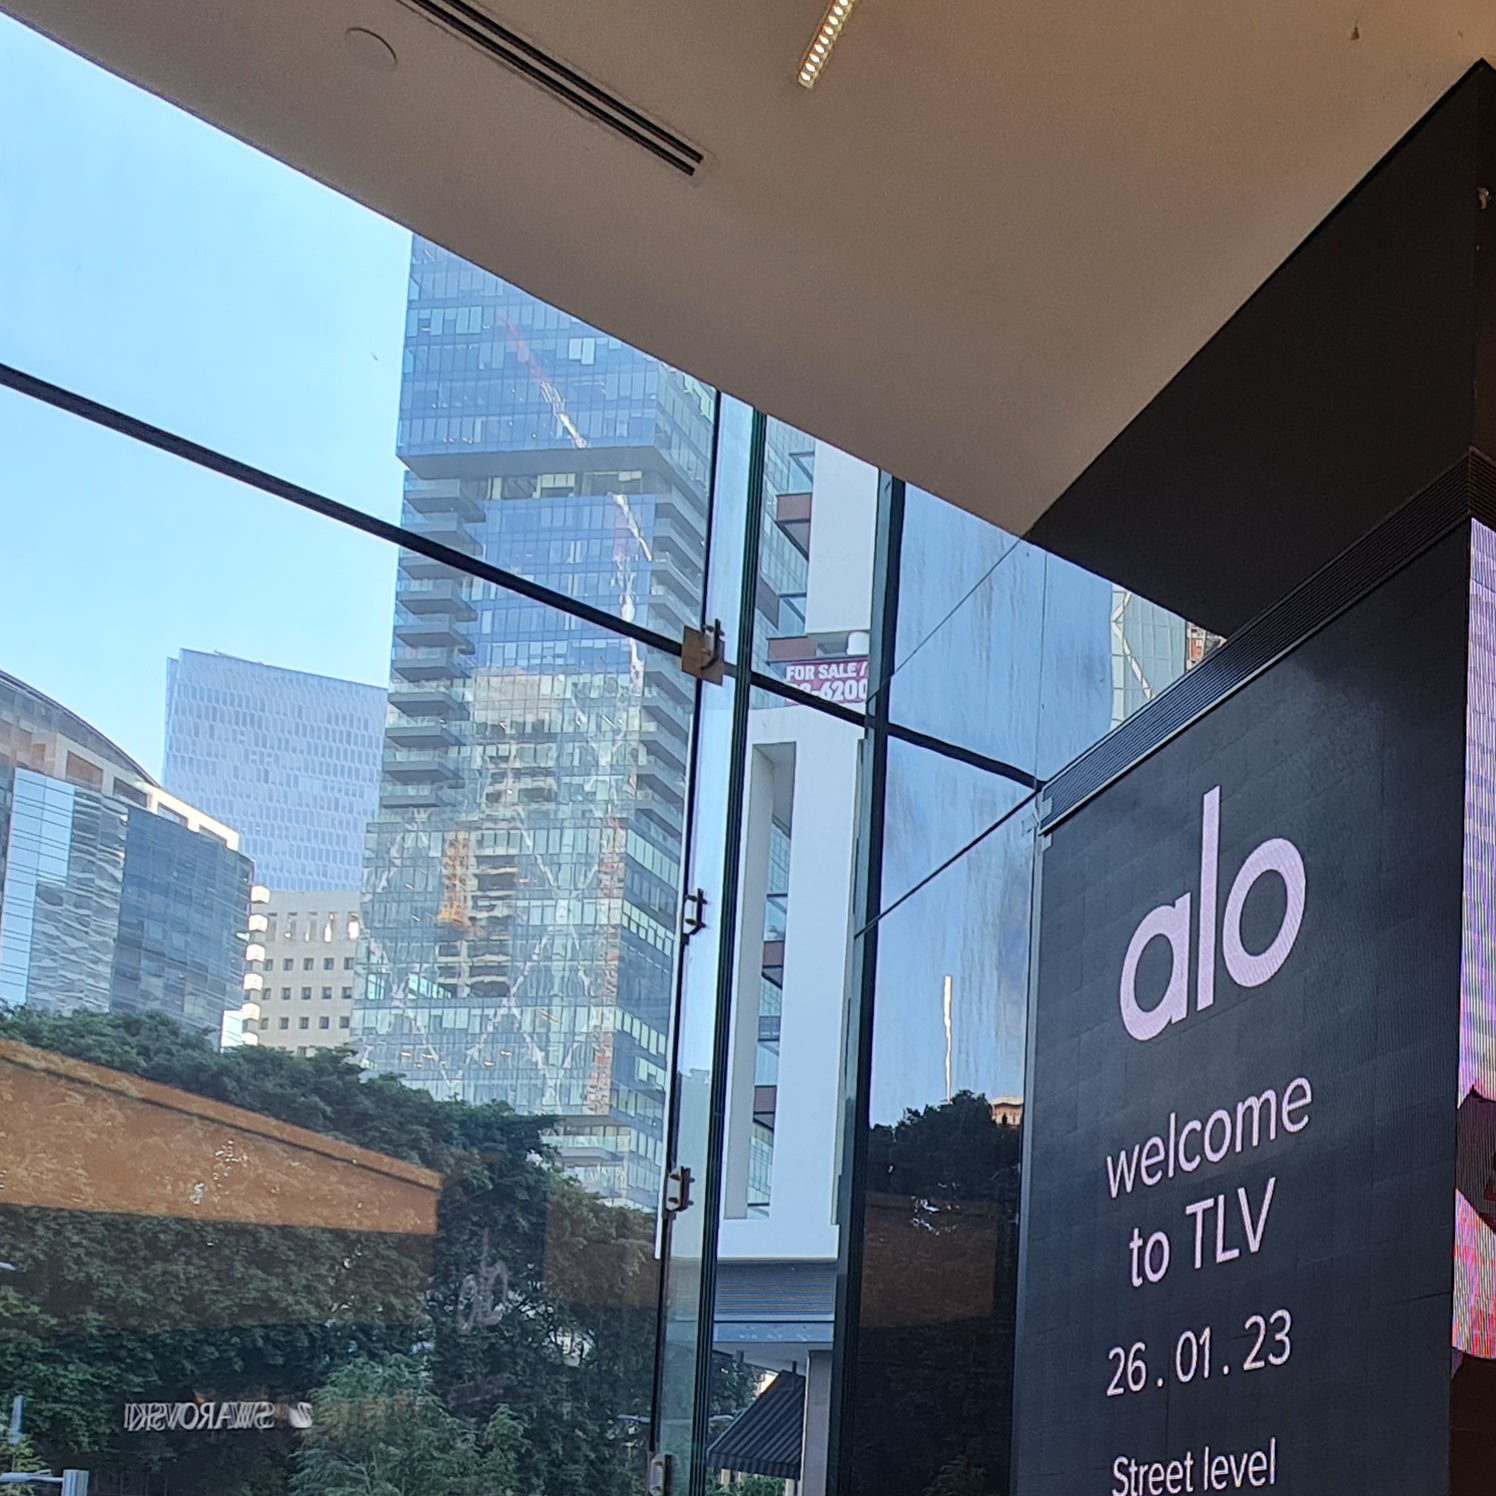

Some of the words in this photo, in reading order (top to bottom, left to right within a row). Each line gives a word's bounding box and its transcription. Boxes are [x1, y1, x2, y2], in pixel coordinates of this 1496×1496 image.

[786, 665, 815, 681] FOR
[818, 662, 857, 680] SALE
[1120, 786, 1305, 1040] alo
[1106, 1077, 1312, 1199] welcome
[1129, 1227, 1170, 1288] to
[1186, 1177, 1276, 1269] TLV
[1203, 1437, 1276, 1491] level
